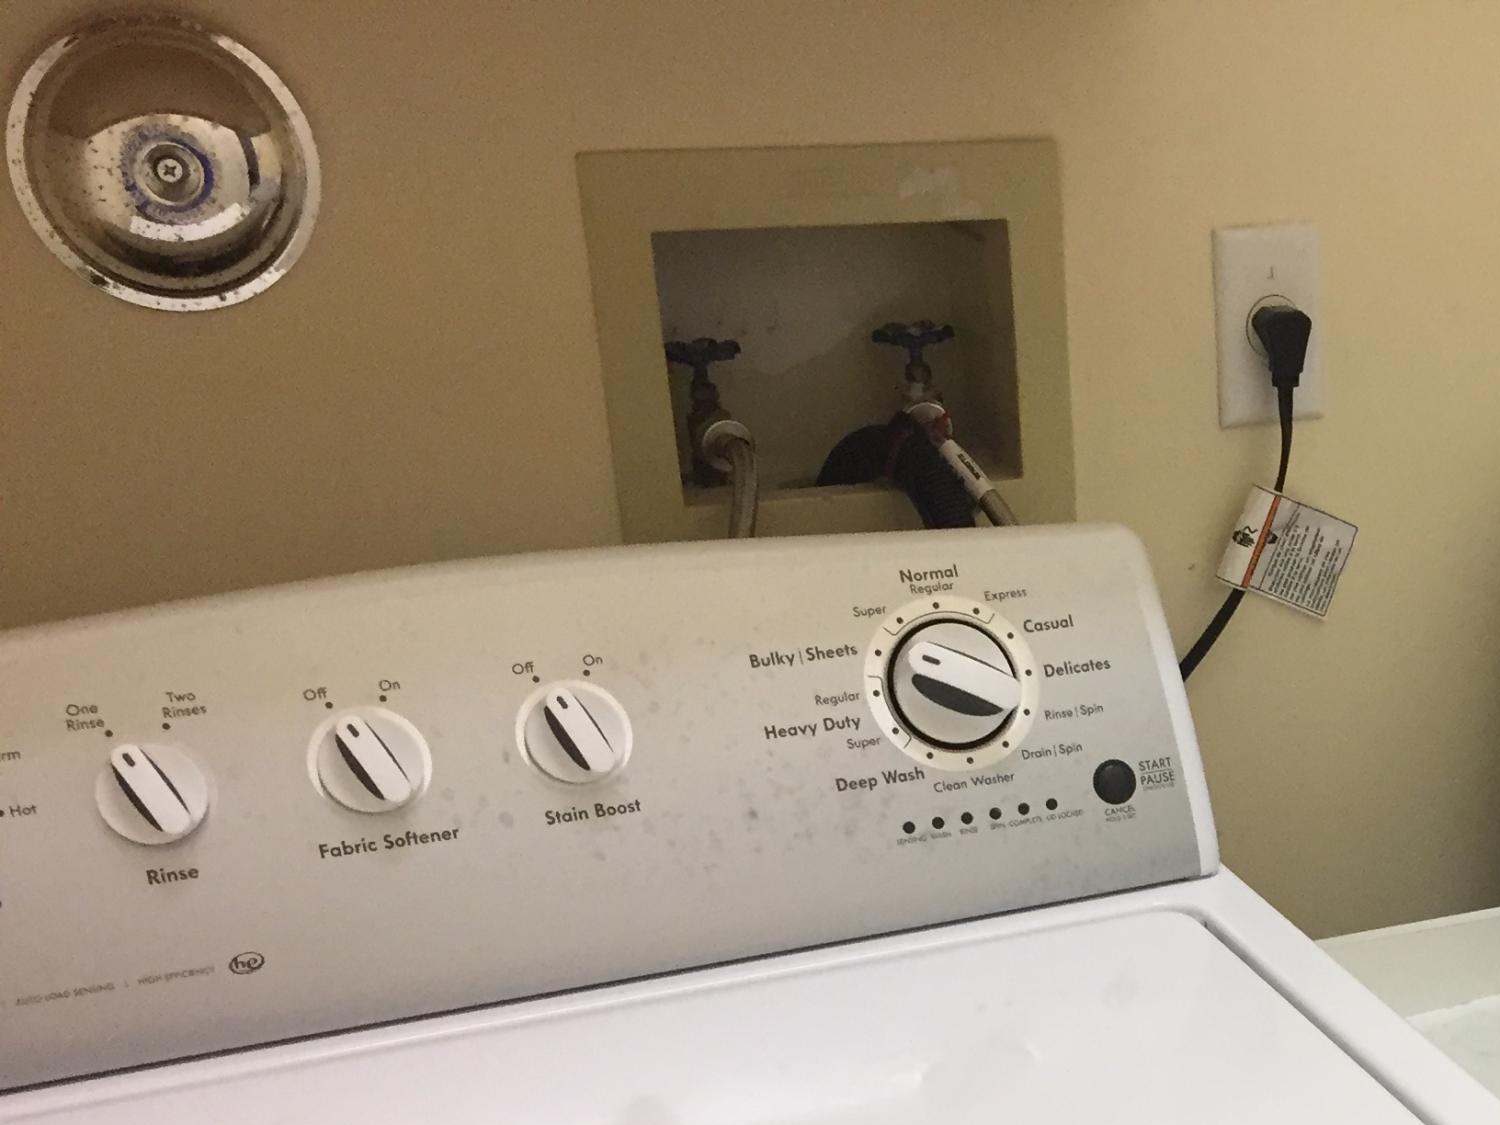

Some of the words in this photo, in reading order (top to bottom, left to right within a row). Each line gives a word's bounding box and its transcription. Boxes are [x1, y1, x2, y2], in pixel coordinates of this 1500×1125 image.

[899, 563, 959, 583] Normal
[909, 581, 954, 597] Regular
[984, 588, 1028, 602] Express
[852, 605, 887, 619] Super
[1023, 614, 1075, 633] Casual
[583, 654, 604, 667] On
[749, 650, 795, 669] Bulky
[805, 643, 859, 662] Sheets
[511, 661, 535, 676] Off
[1043, 658, 1112, 678] Delicates
[378, 679, 401, 692] On
[165, 691, 196, 703] Two
[302, 686, 328, 702] Off
[814, 691, 860, 707] Regular
[65, 703, 99, 717] One
[161, 705, 207, 719] Rinses
[1044, 708, 1073, 721] Rinse
[1079, 703, 1105, 717] Spin
[65, 718, 105, 732] Rinse
[764, 721, 818, 740] Heavy
[822, 715, 862, 732] Duty
[846, 735, 882, 750] Super
[0, 750, 22, 762] rm
[1021, 747, 1053, 761] Drain
[1058, 742, 1084, 757] Spin
[1138, 757, 1172, 772] START
[835, 775, 878, 793] Deep
[881, 766, 926, 784] Wash
[933, 780, 968, 794] Clean
[970, 772, 1016, 788] Washer
[1140, 770, 1175, 786] PAUSE
[9, 803, 38, 818] Hot
[544, 807, 590, 826] Stain
[593, 799, 643, 819] Boost
[317, 837, 379, 859] Fabric
[382, 826, 461, 850] Softener
[145, 867, 200, 886] Rinse
